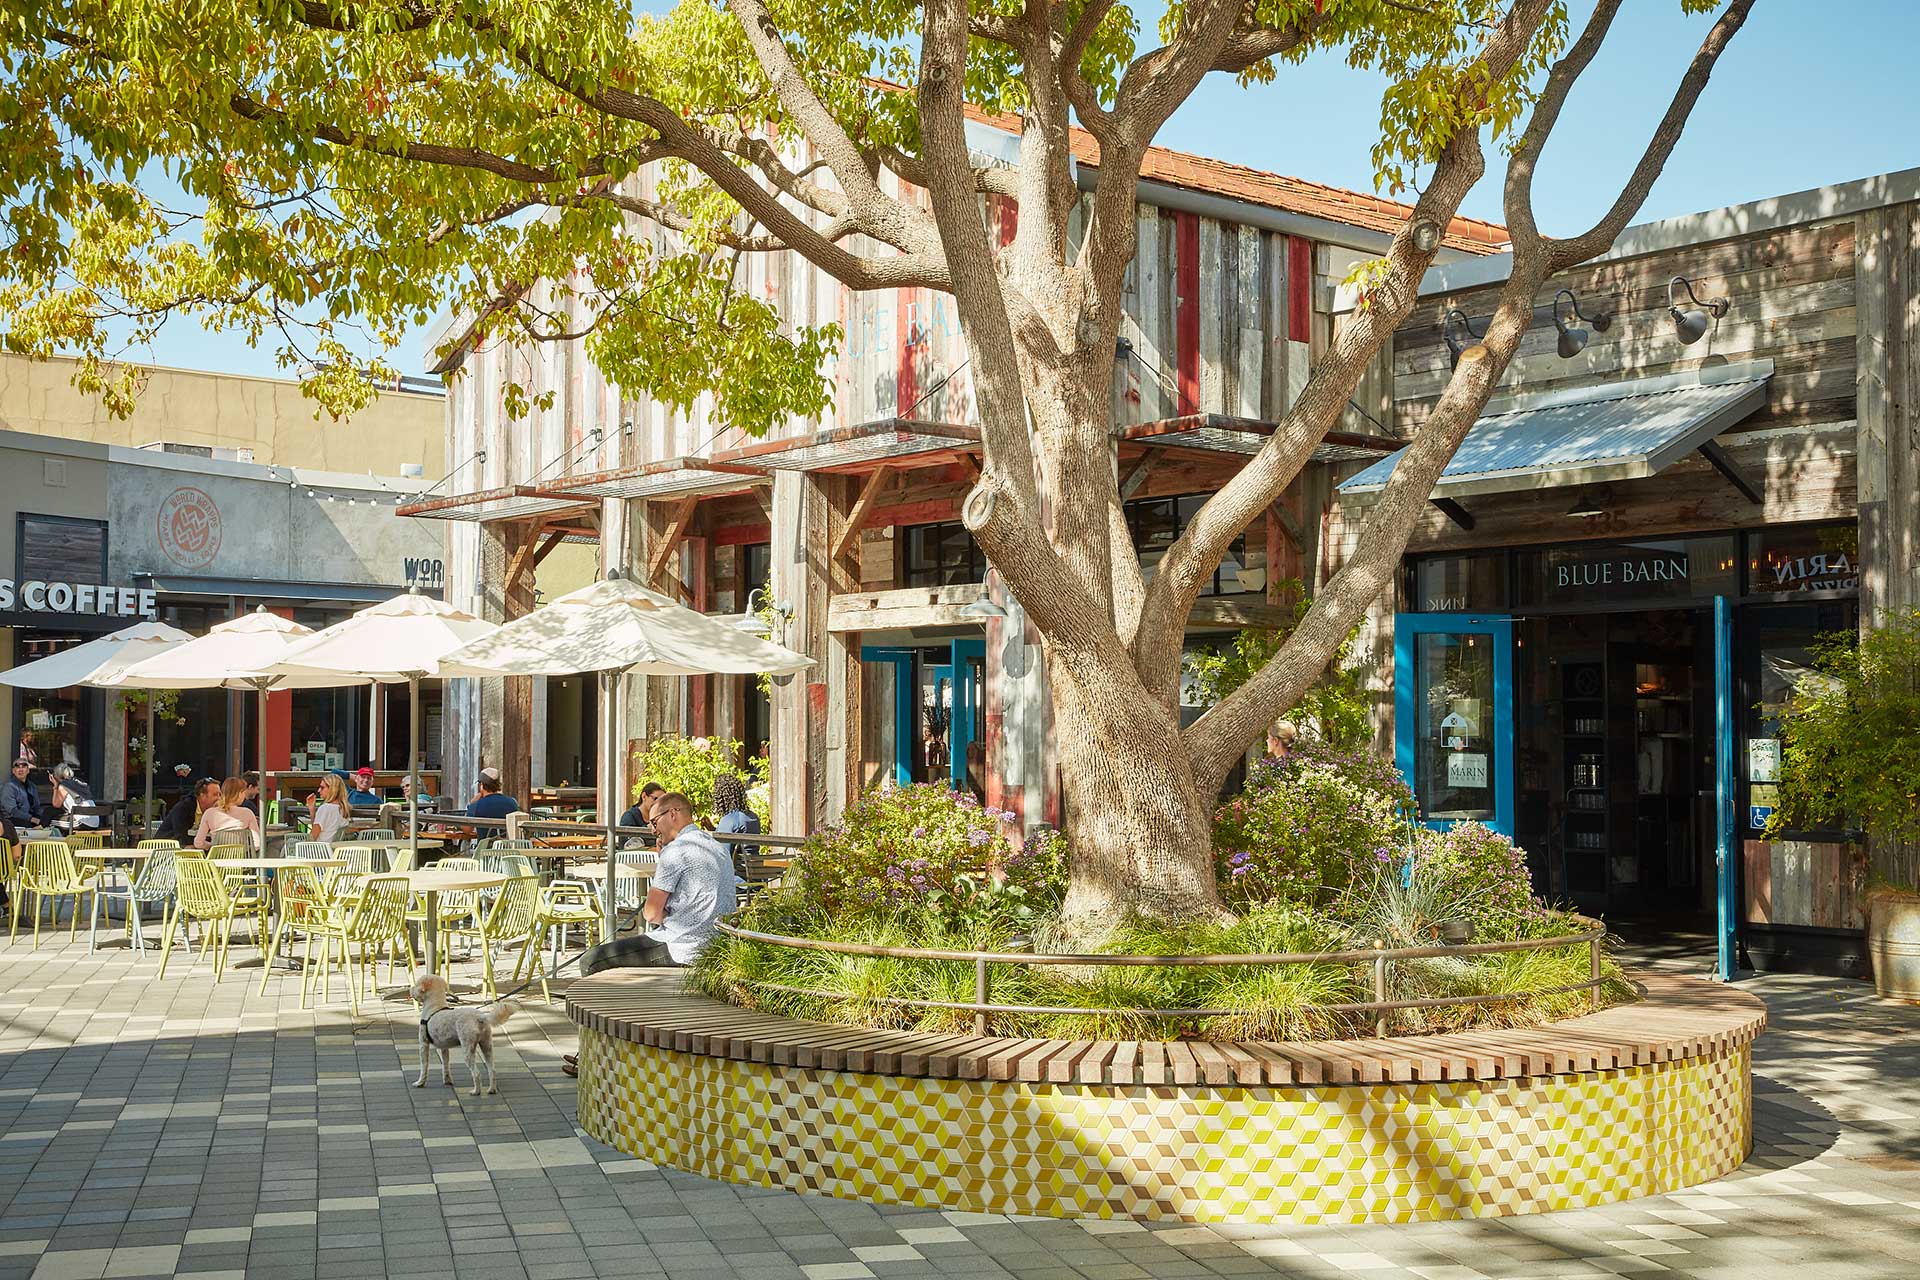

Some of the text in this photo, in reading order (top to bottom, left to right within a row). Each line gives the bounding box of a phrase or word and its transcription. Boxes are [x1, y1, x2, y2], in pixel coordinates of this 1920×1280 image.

[905, 296, 962, 346] BA
[169, 492, 195, 509] WORLD
[404, 557, 445, 582] WOR
[1557, 558, 1688, 586] BLUE BARN
[23, 580, 157, 616] COFFEE
[1450, 767, 1486, 777] MARIN
